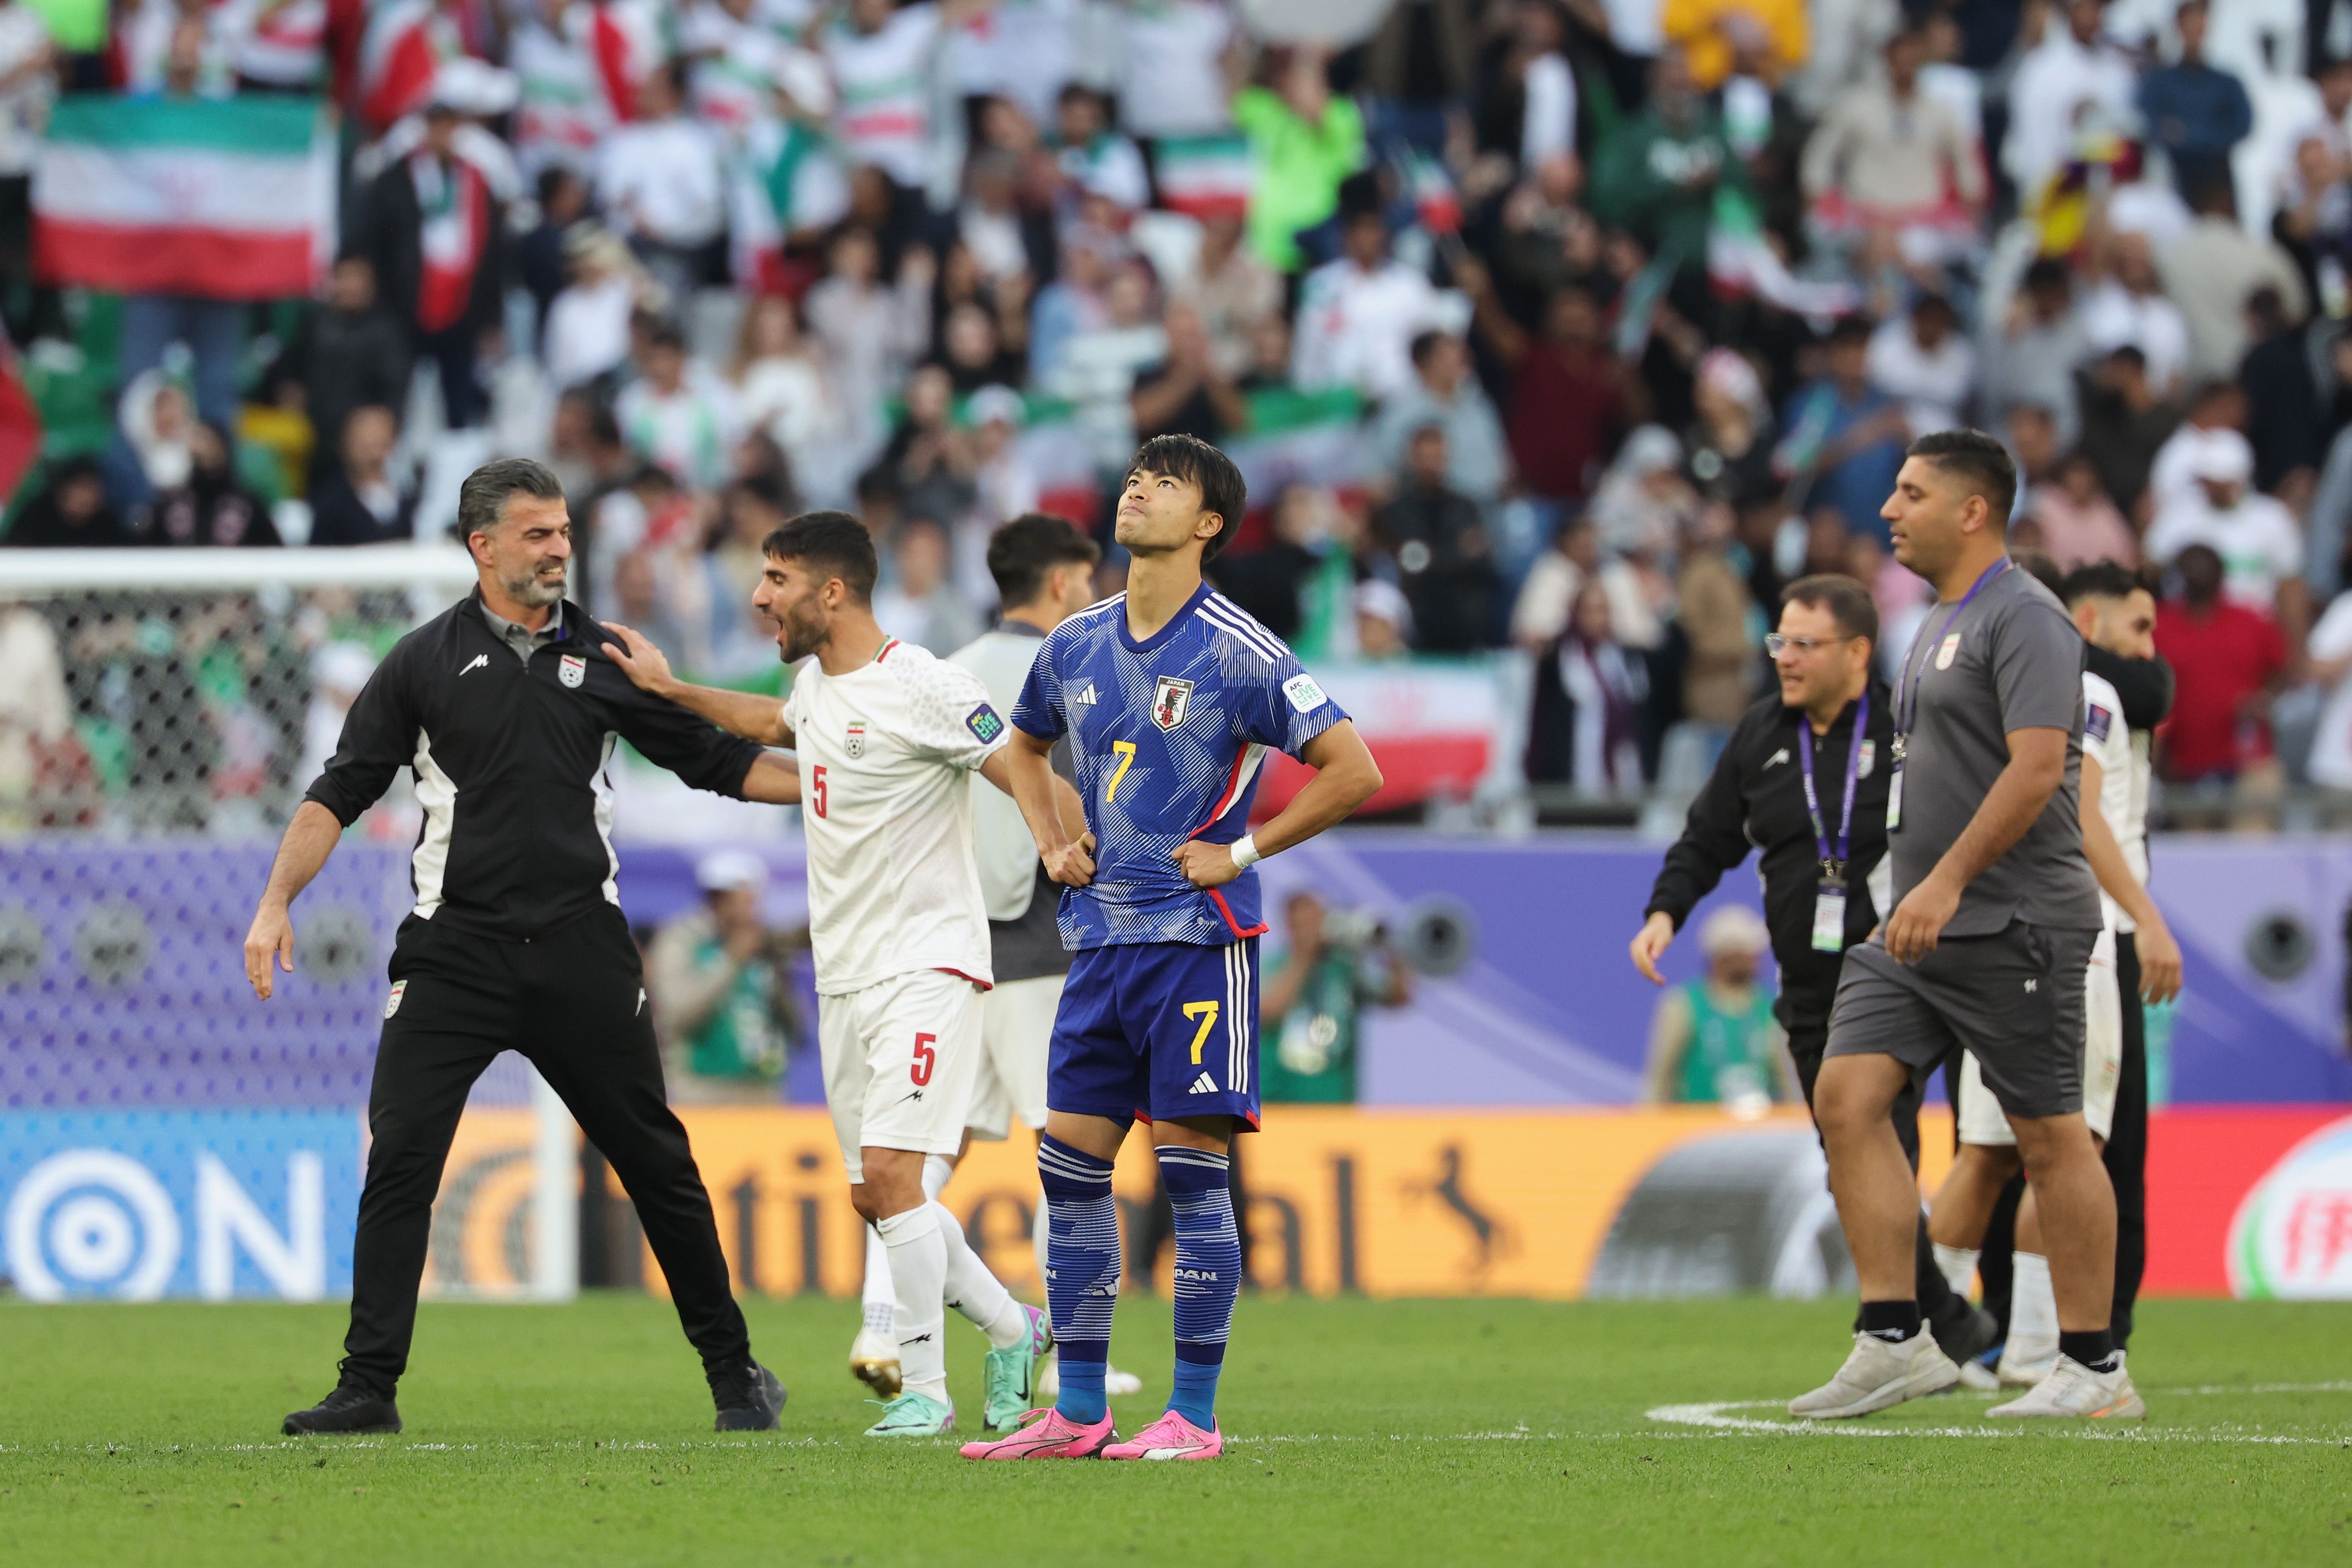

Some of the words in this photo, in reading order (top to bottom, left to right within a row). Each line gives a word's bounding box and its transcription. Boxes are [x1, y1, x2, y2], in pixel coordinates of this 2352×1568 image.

[1289, 681, 1303, 692] AFC
[1292, 684, 1315, 699] LIVE
[1159, 713, 1174, 723] JFA
[813, 765, 827, 819] 5
[1106, 740, 1137, 803] 7
[911, 1032, 936, 1086] 5
[1183, 1001, 1218, 1064] 7
